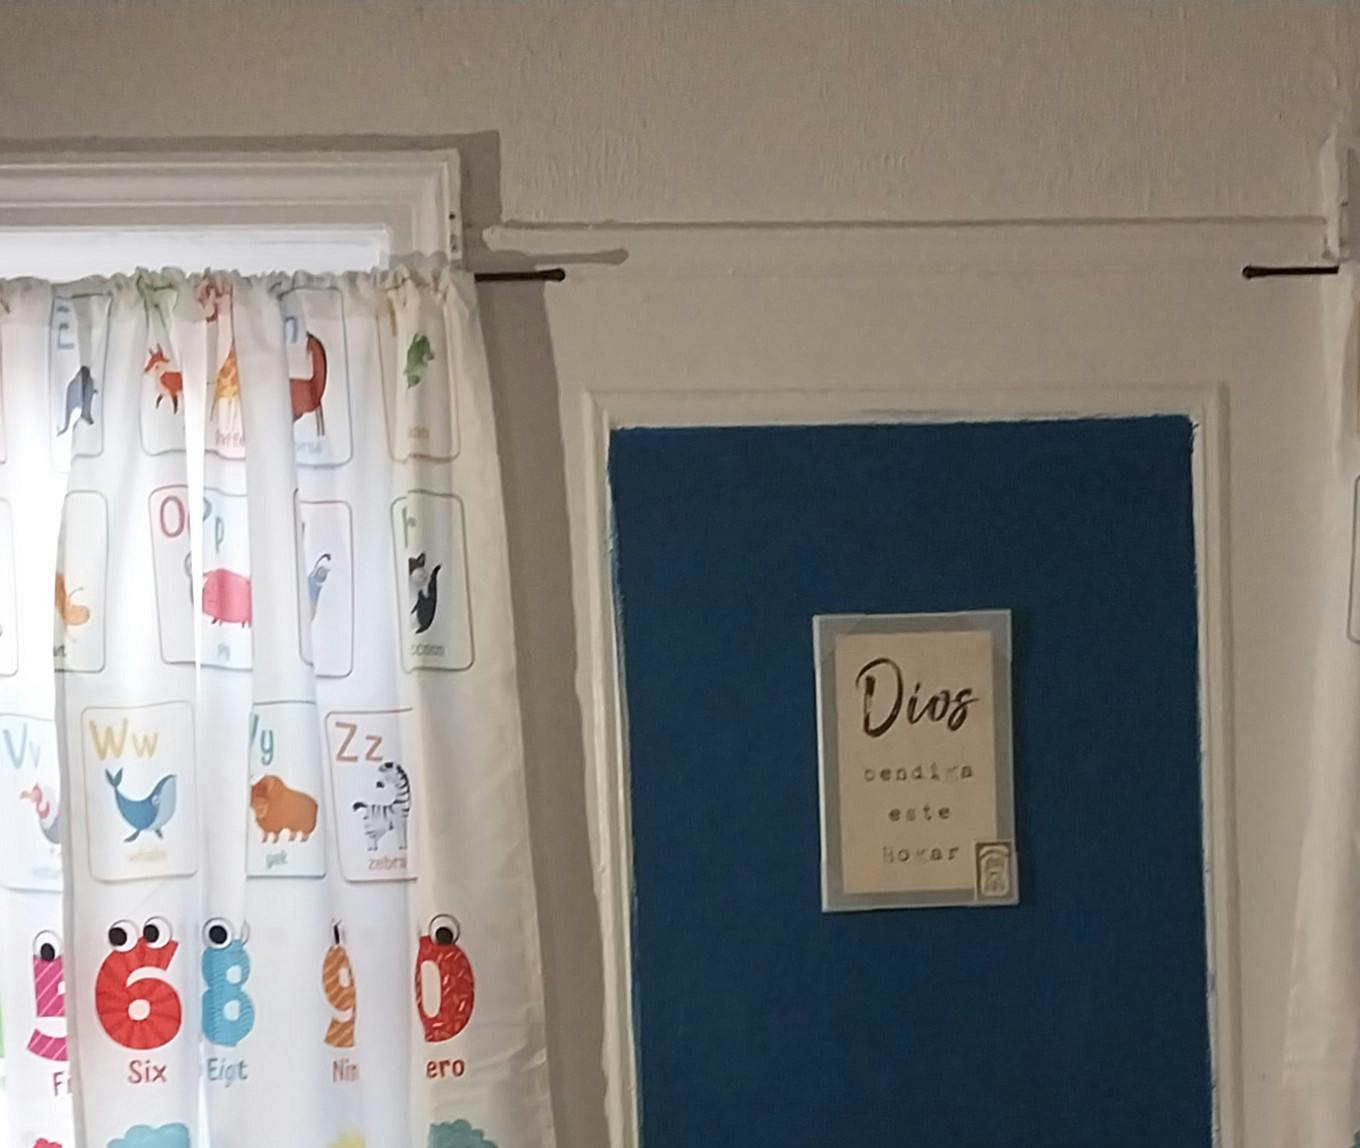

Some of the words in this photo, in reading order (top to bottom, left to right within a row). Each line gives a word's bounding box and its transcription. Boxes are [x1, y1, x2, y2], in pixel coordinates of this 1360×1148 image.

[854, 656, 981, 738] Dios
[87, 715, 160, 763] Ww
[334, 720, 385, 763] Zz
[887, 803, 952, 822] este
[94, 936, 183, 1051] 6
[201, 938, 256, 1048] 8
[127, 1059, 168, 1085] Six
[425, 1058, 466, 1079] ero
